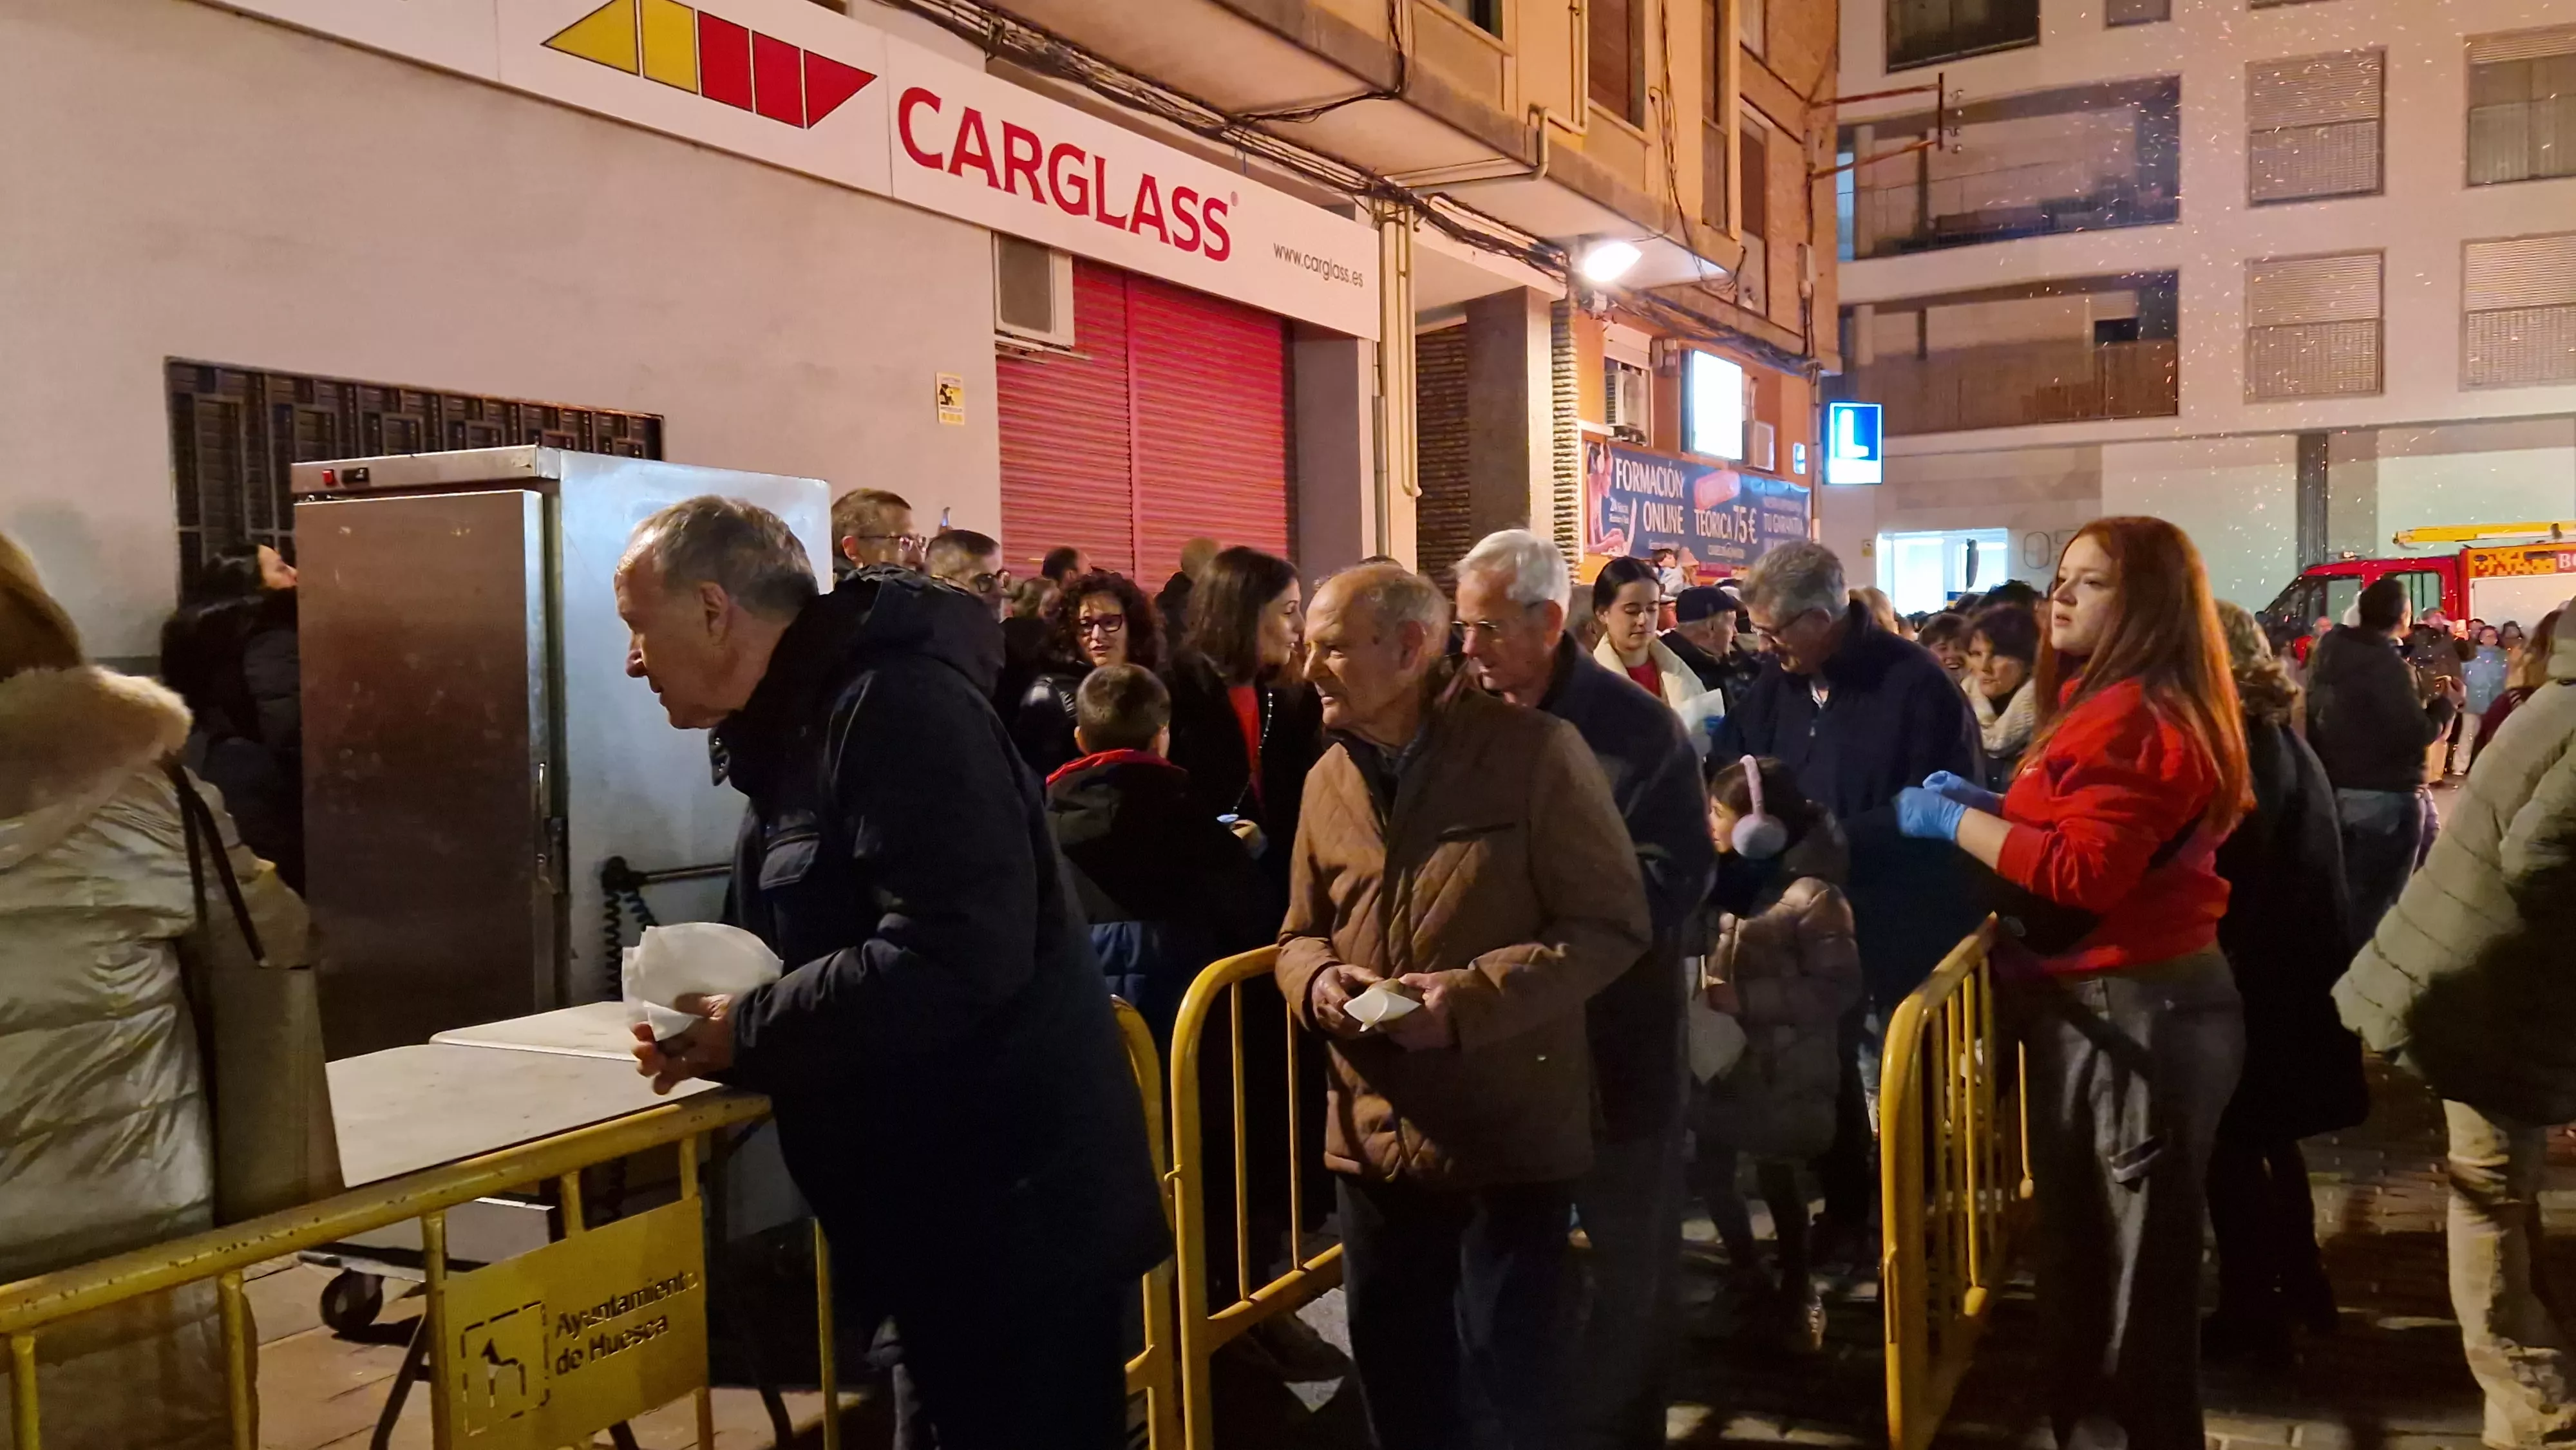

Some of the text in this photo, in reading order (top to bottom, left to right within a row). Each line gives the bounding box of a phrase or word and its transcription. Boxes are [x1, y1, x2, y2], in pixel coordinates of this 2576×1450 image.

[898, 86, 1231, 262] CARGLASS
[1273, 242, 1363, 288] www.carglass.es
[1615, 458, 1685, 498] FORMACIÓN
[1643, 500, 1684, 534] ONLINE
[556, 1270, 698, 1341] Ayuntamiento
[556, 1315, 669, 1375] de Huesca
